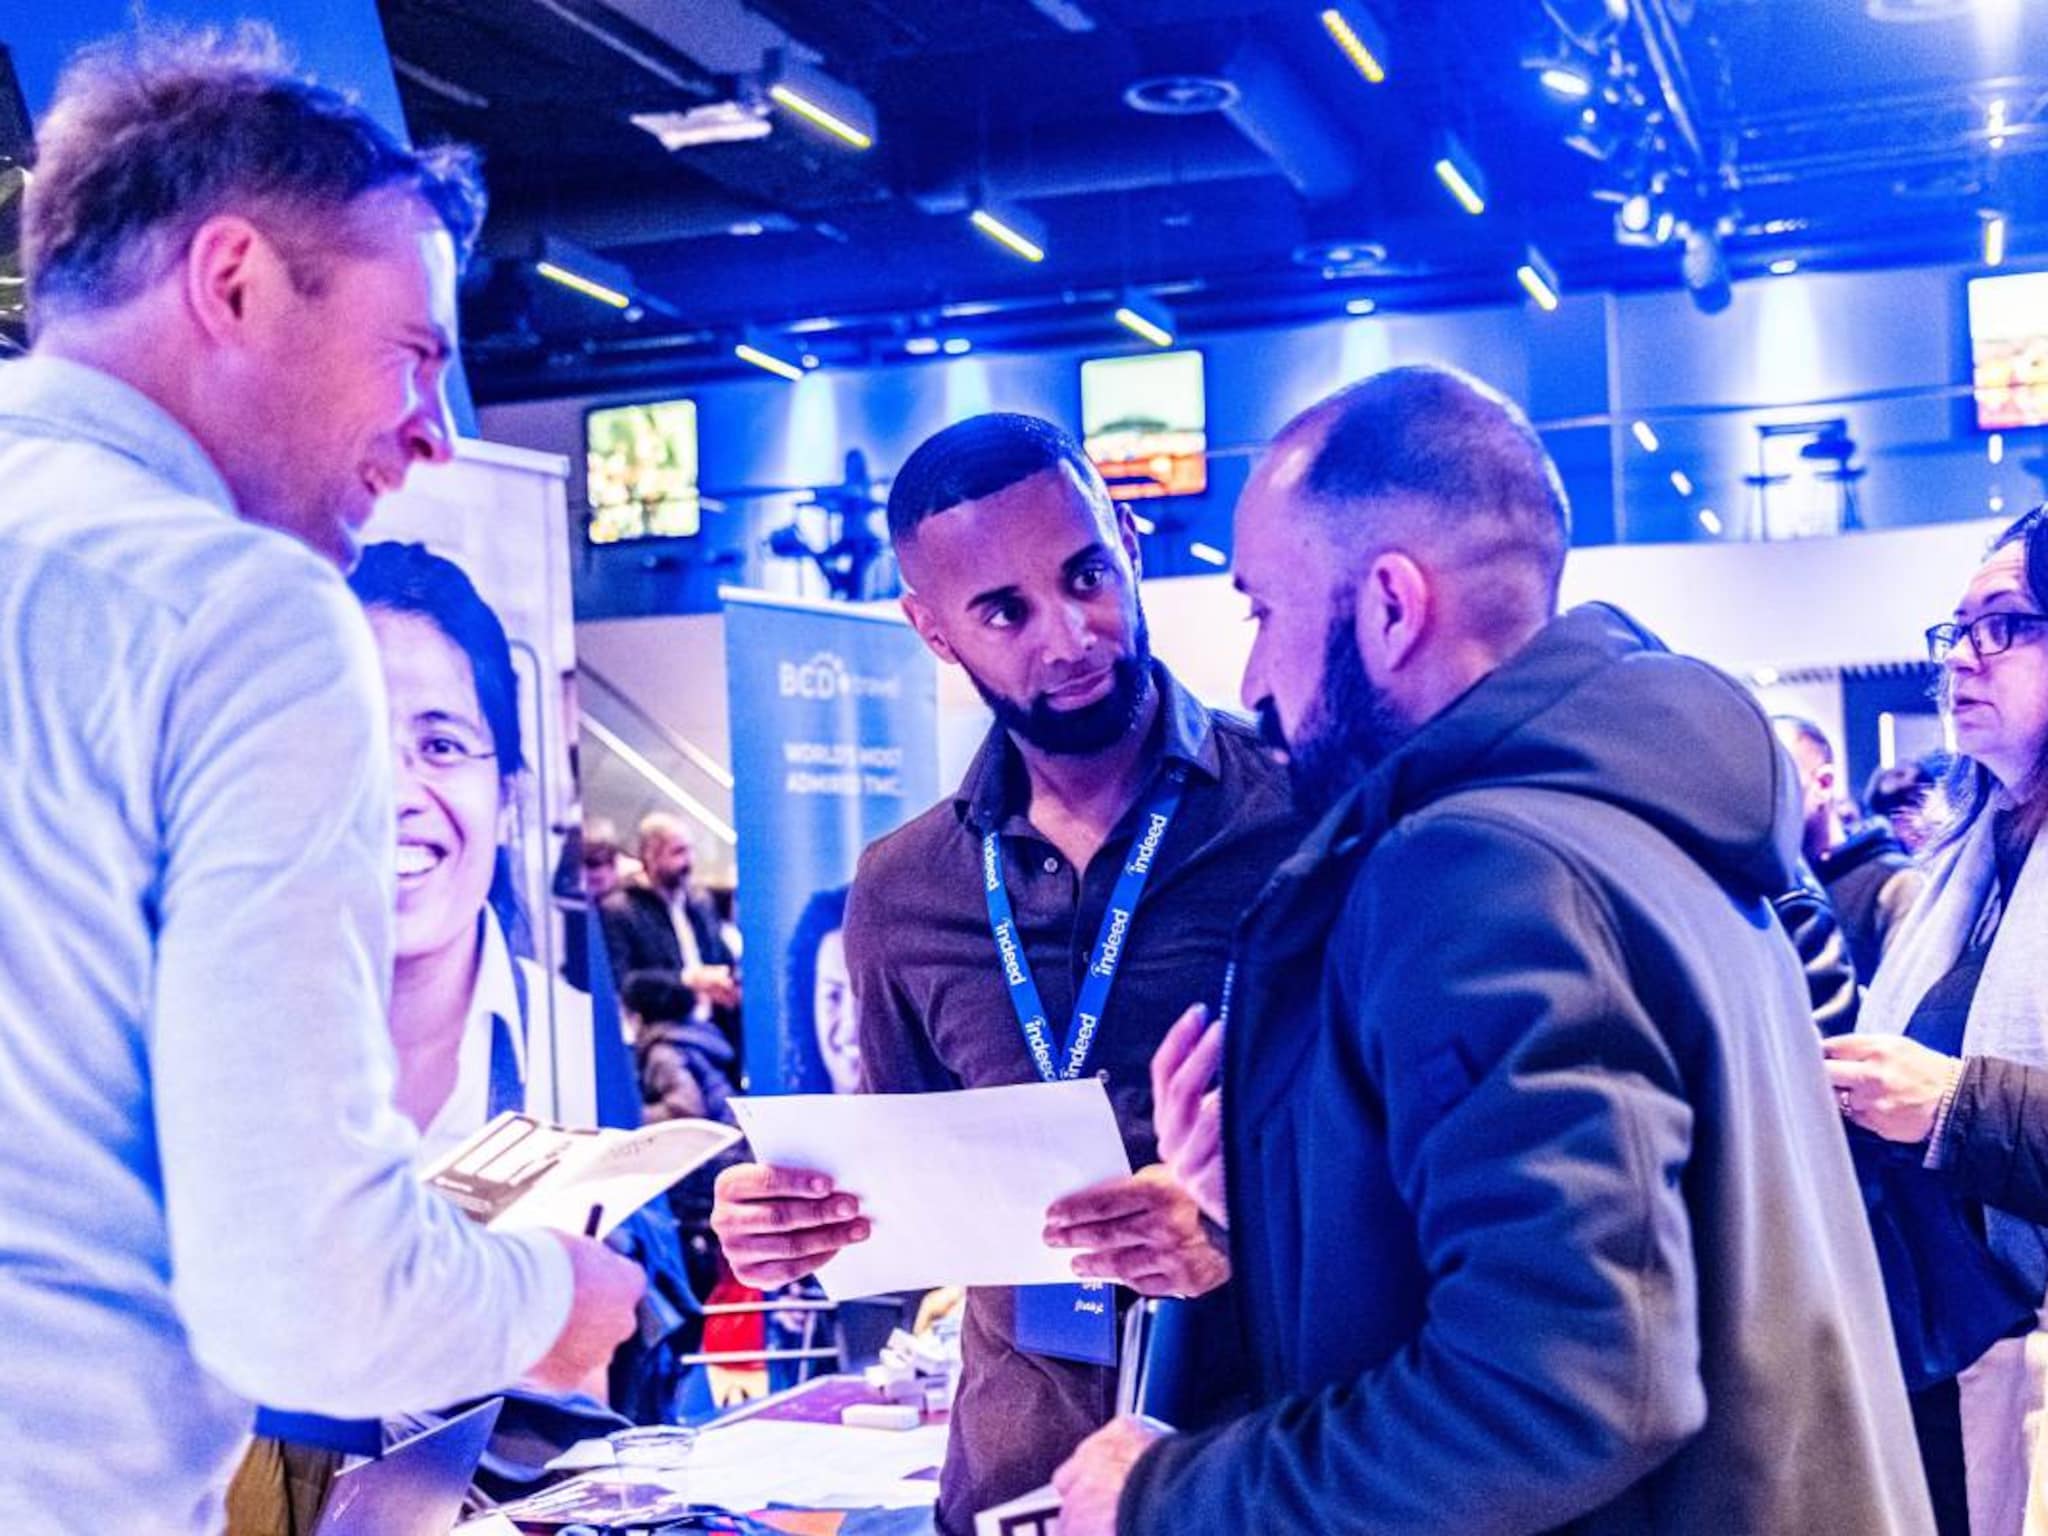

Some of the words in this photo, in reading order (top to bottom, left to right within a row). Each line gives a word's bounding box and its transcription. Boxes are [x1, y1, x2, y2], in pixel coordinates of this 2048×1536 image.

[778, 660, 835, 699] BCD
[984, 832, 1000, 891] indeed
[1126, 814, 1167, 876] indeed
[996, 917, 1027, 986] indeed
[1091, 908, 1129, 977] indeed
[1061, 1013, 1097, 1079] indeed
